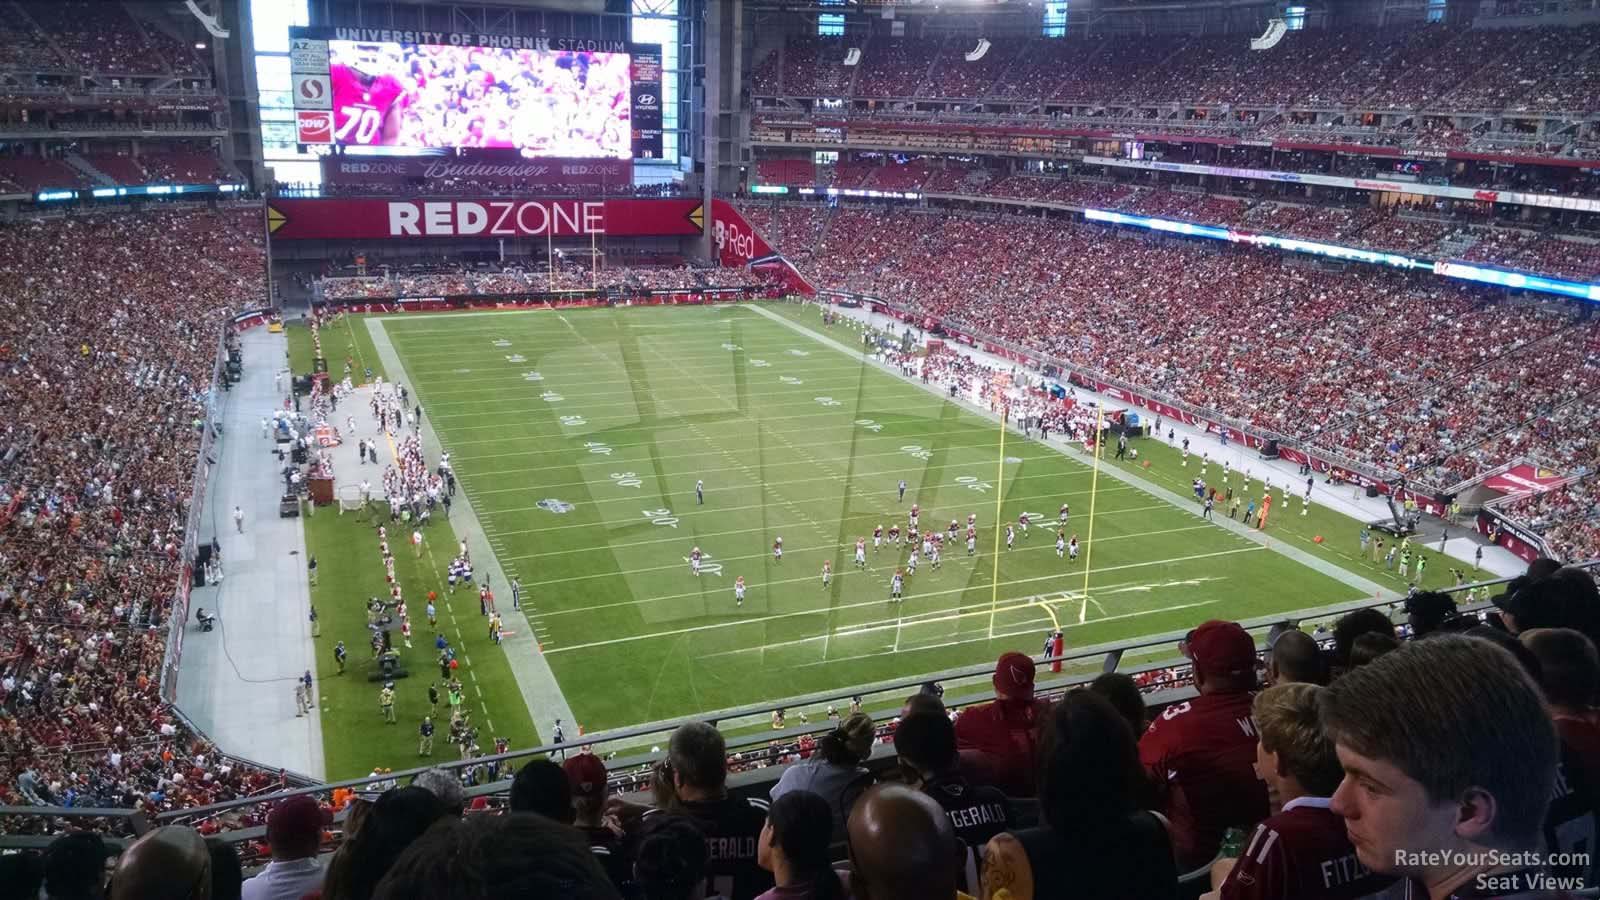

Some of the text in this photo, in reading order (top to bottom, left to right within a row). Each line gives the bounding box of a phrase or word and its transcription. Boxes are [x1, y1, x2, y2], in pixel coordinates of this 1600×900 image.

[335, 27, 625, 52] UNIVERSITY OF PHOENIX STADIUM
[299, 119, 326, 129] CDW
[335, 106, 380, 144] 70
[341, 163, 407, 174] REDZONE
[418, 158, 549, 178] Budweiser
[562, 165, 620, 175] REDZONE
[388, 201, 605, 235] REDZONE
[945, 804, 1006, 828] GERALD
[1245, 823, 1279, 864] 11
